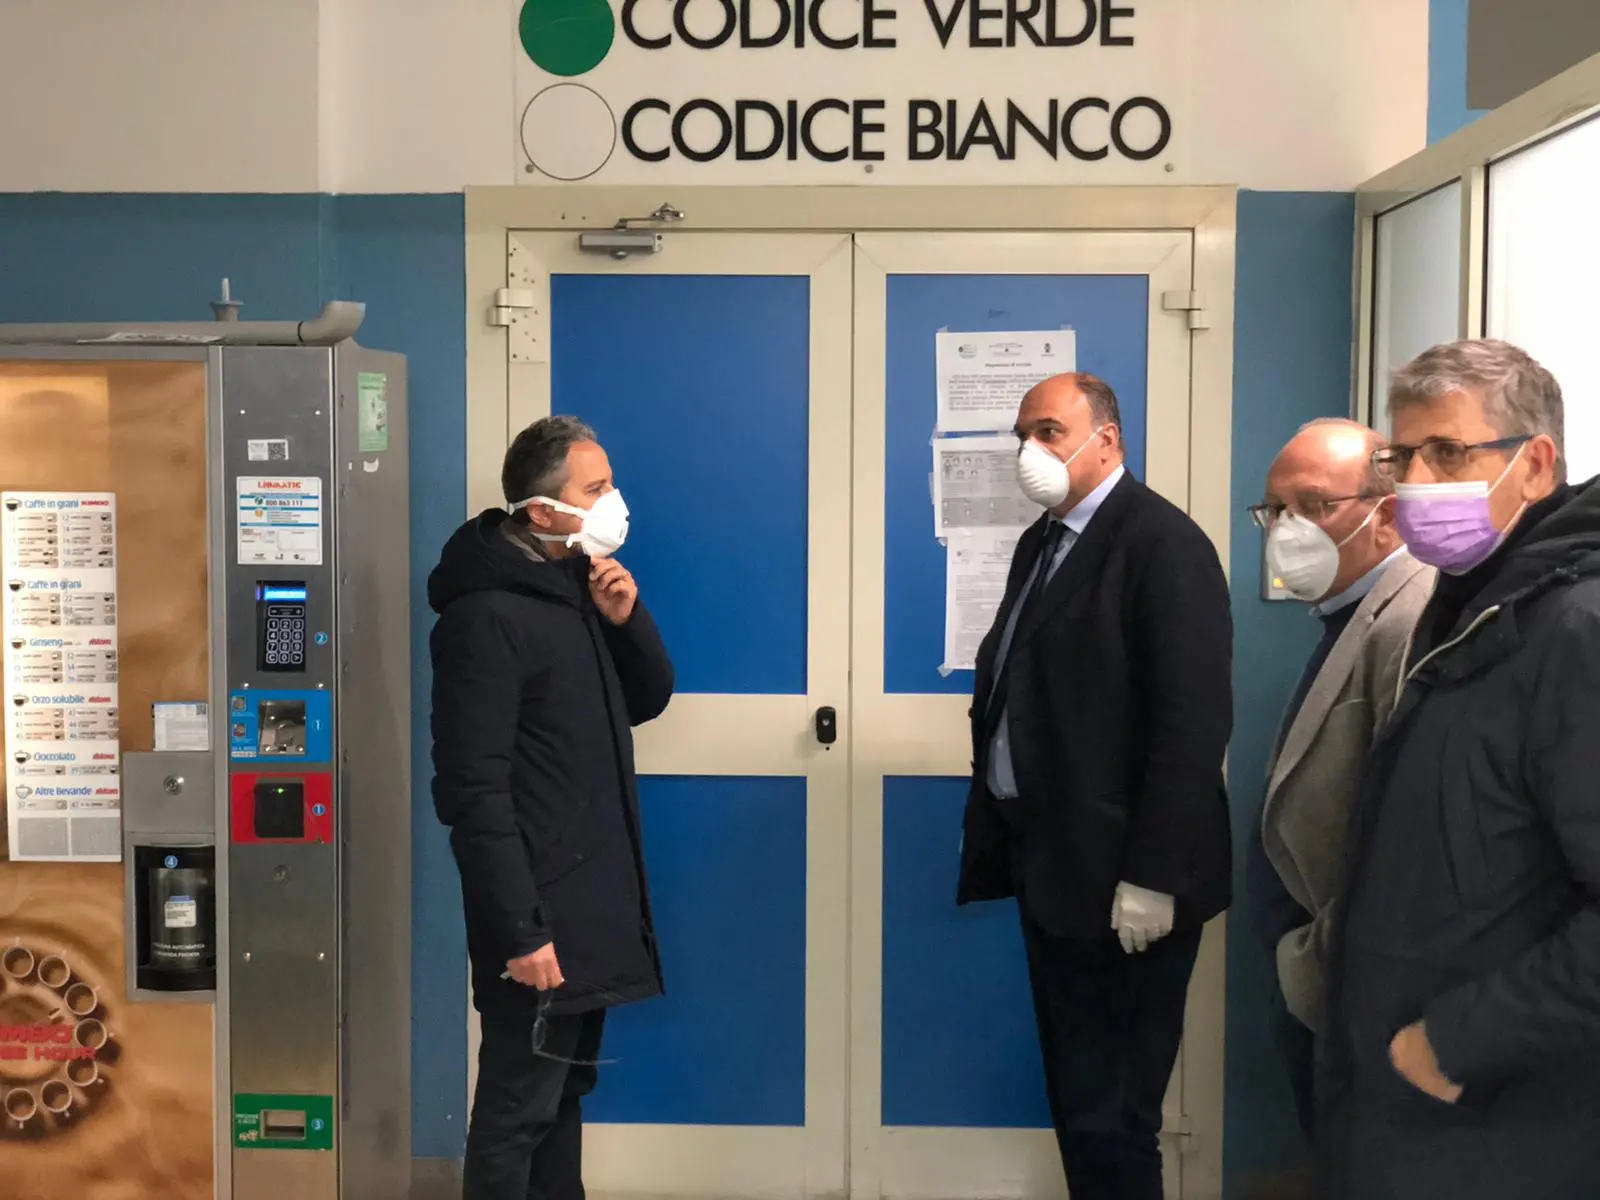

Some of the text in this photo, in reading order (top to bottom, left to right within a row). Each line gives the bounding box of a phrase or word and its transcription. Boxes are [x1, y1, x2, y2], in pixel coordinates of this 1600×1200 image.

[621, 0, 1135, 50] CODICE VERDE
[621, 95, 1171, 163] CODICE BIANCO
[30, 638, 63, 648] Ginseng
[52, 694, 84, 704] solubile
[56, 786, 92, 796] Bevande
[34, 1046, 97, 1062] HOUR
